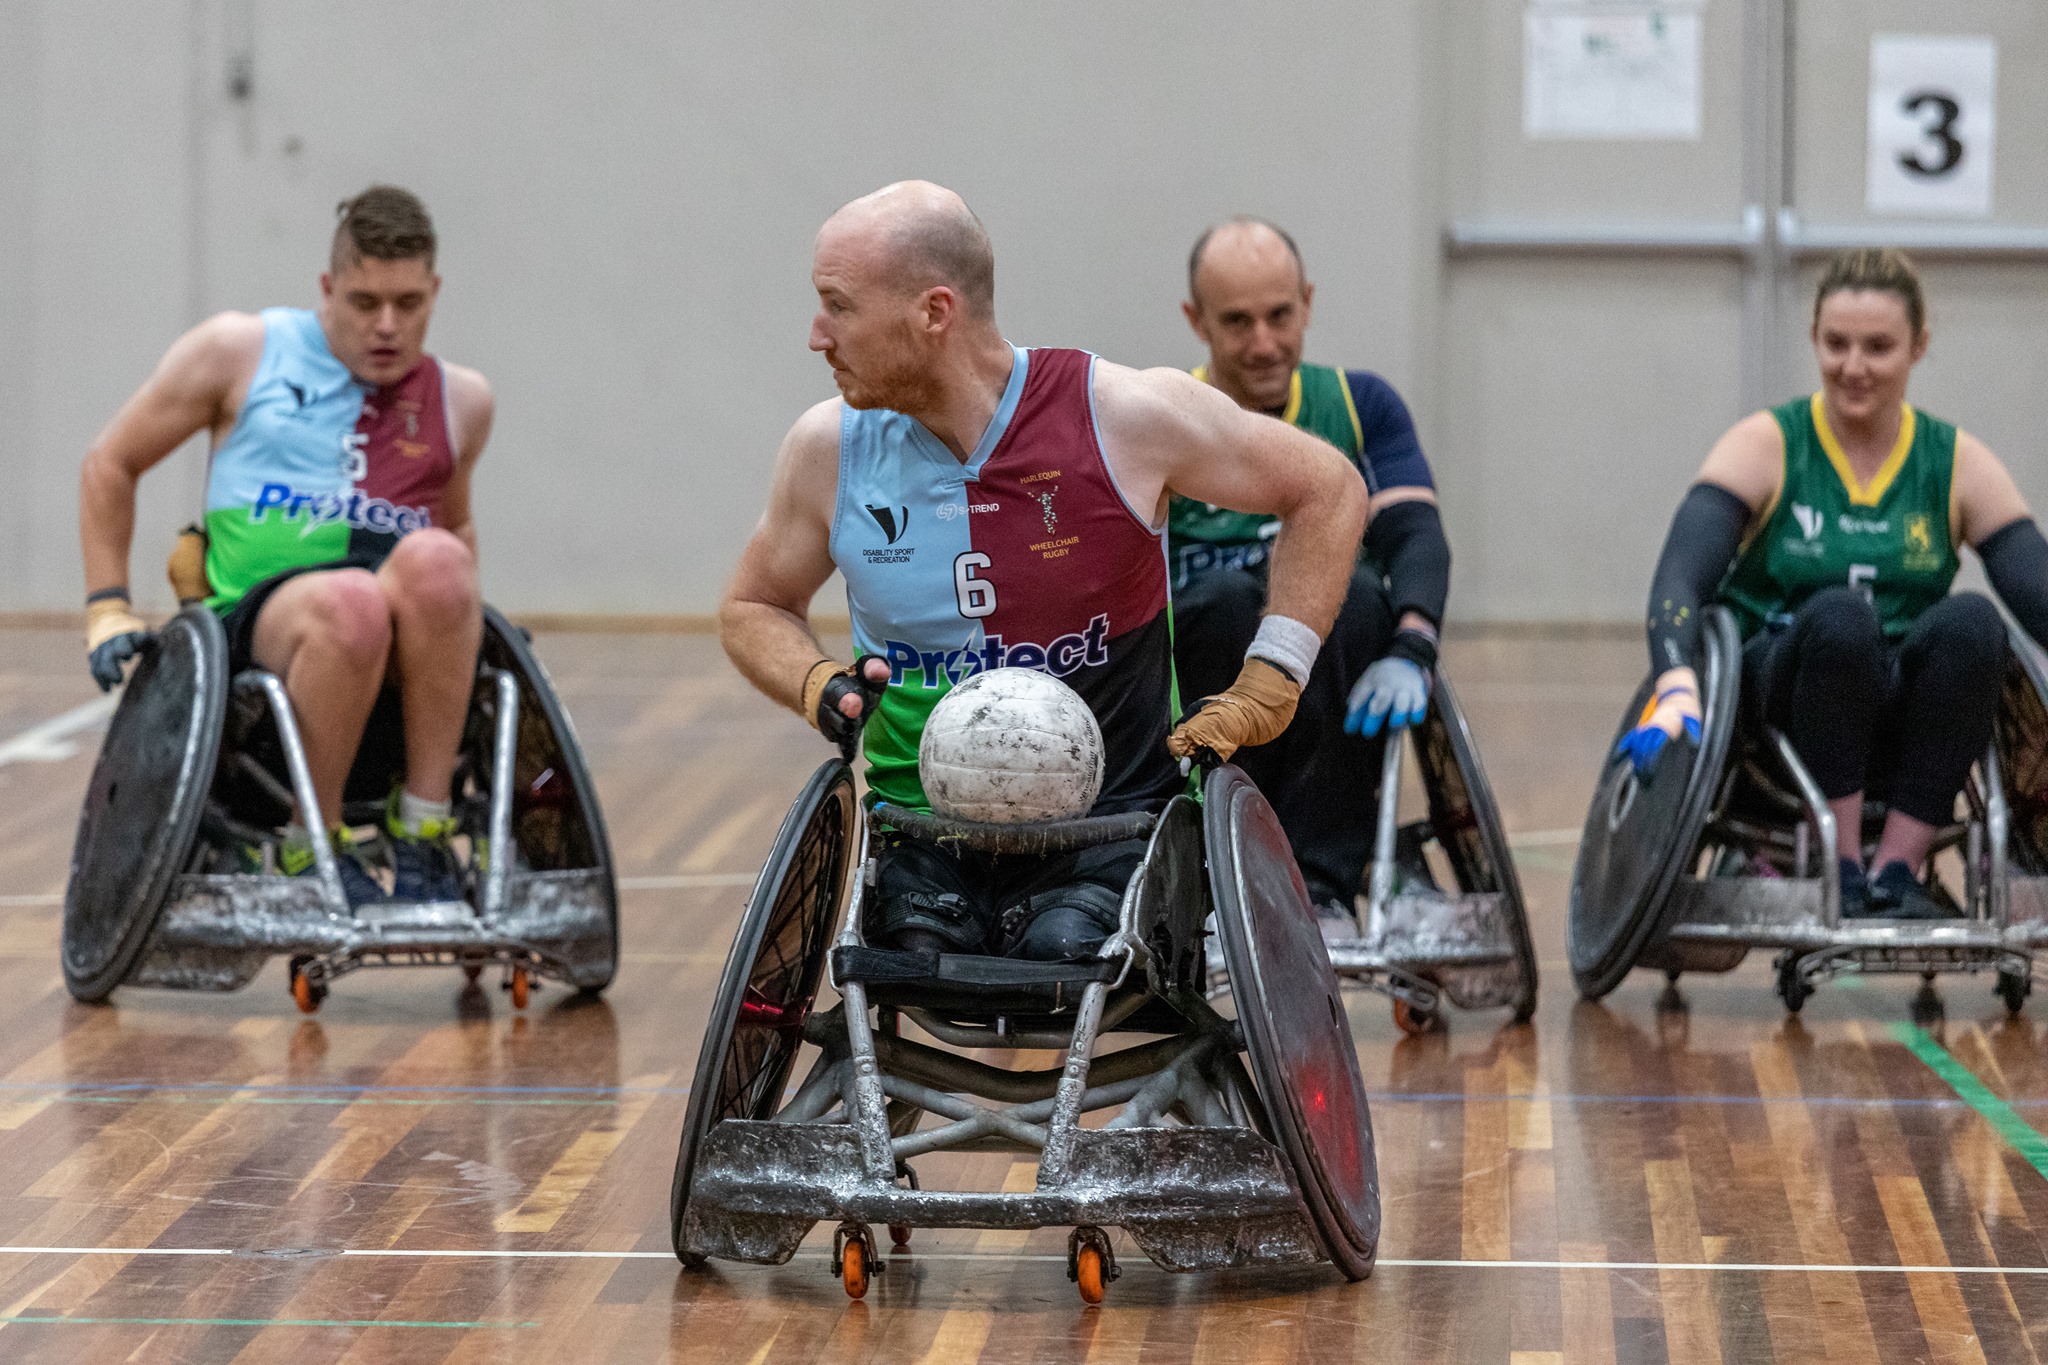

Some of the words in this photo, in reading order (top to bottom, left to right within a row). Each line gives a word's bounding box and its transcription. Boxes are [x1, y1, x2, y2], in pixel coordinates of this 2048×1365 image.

[1898, 91, 1963, 180] 3
[342, 432, 370, 481] 5
[1020, 469, 1061, 484] HARLEQUIN
[862, 549, 893, 557] DISABILITY
[894, 547, 915, 556] SPORT
[1029, 536, 1080, 552] WHEELCHAIR
[872, 555, 911, 564] RECREATION
[1043, 548, 1070, 560] RUGBY
[953, 551, 997, 619] 6
[884, 612, 1110, 689] Protect
